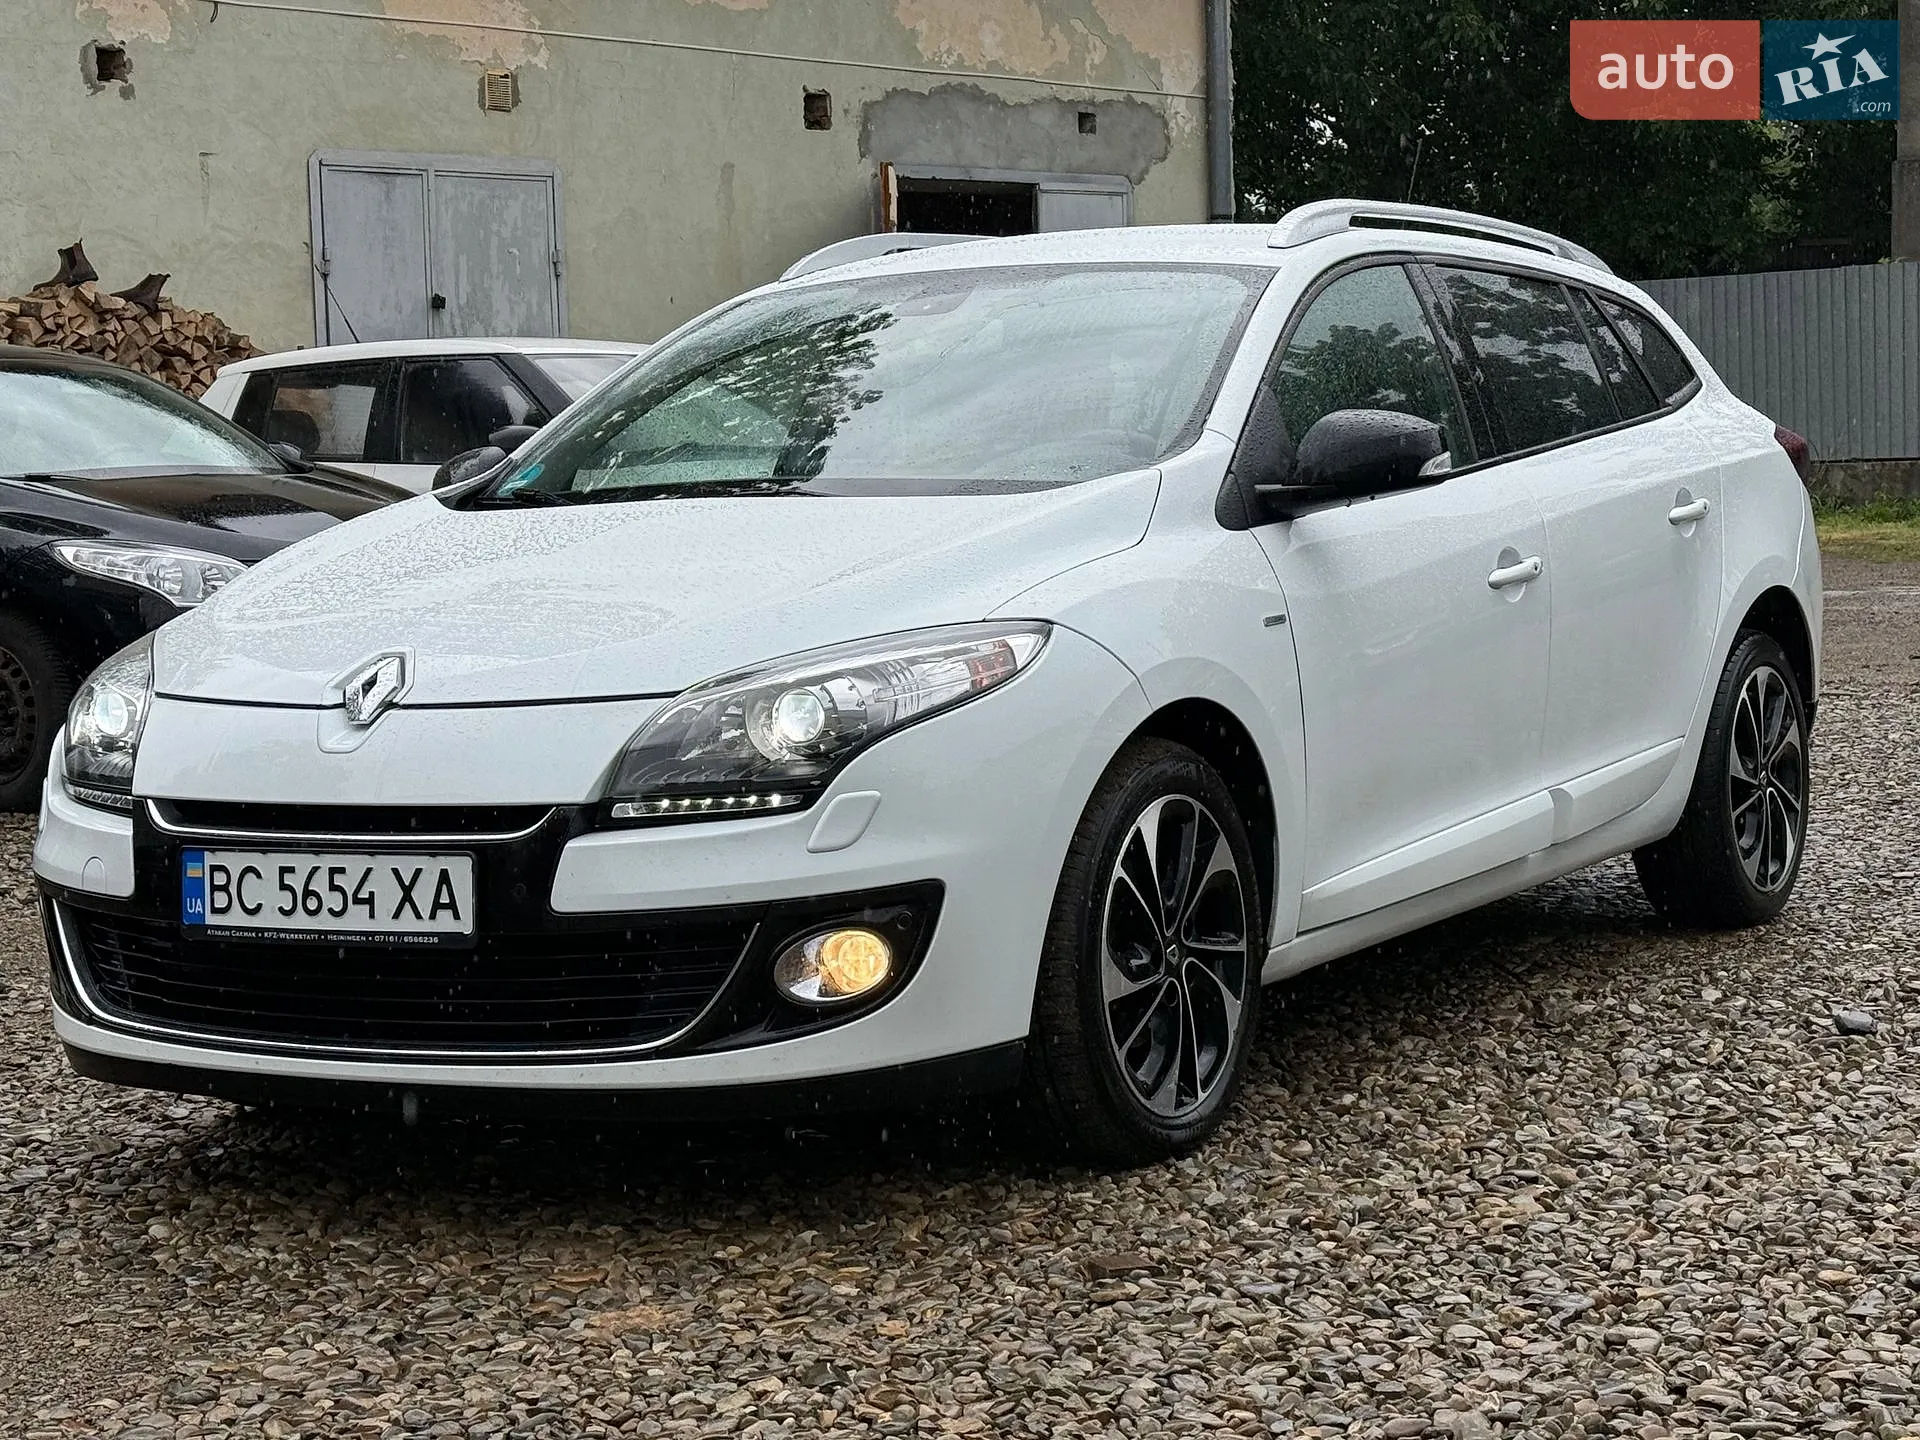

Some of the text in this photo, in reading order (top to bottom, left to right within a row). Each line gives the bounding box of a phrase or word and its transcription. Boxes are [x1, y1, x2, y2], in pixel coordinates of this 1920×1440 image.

[187, 897, 203, 914] UA
[209, 863, 462, 921] BC 5654 XA
